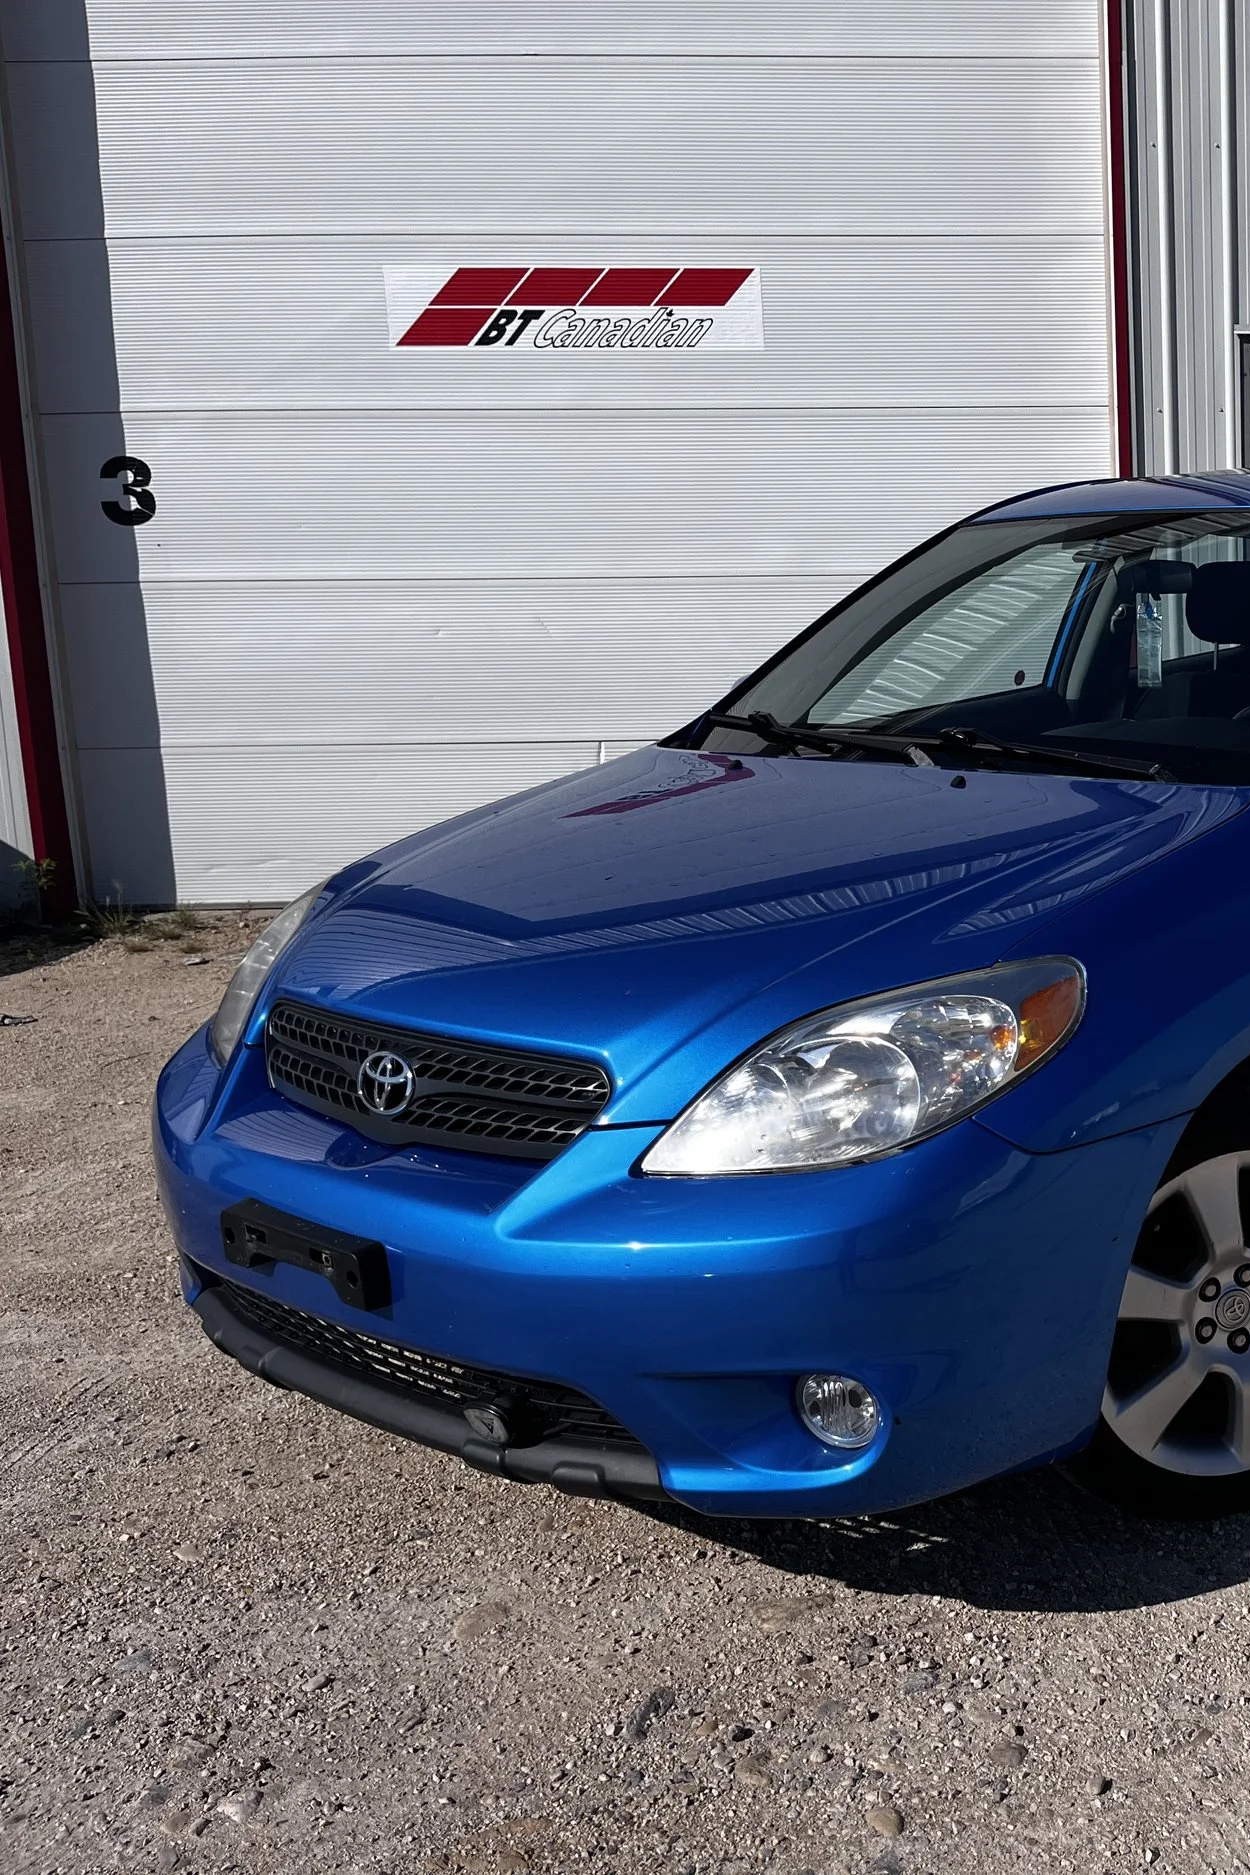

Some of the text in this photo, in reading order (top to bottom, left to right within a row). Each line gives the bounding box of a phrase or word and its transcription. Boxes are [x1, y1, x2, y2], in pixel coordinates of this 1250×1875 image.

[474, 307, 714, 348] BT Canadian
[100, 455, 156, 526] 3
